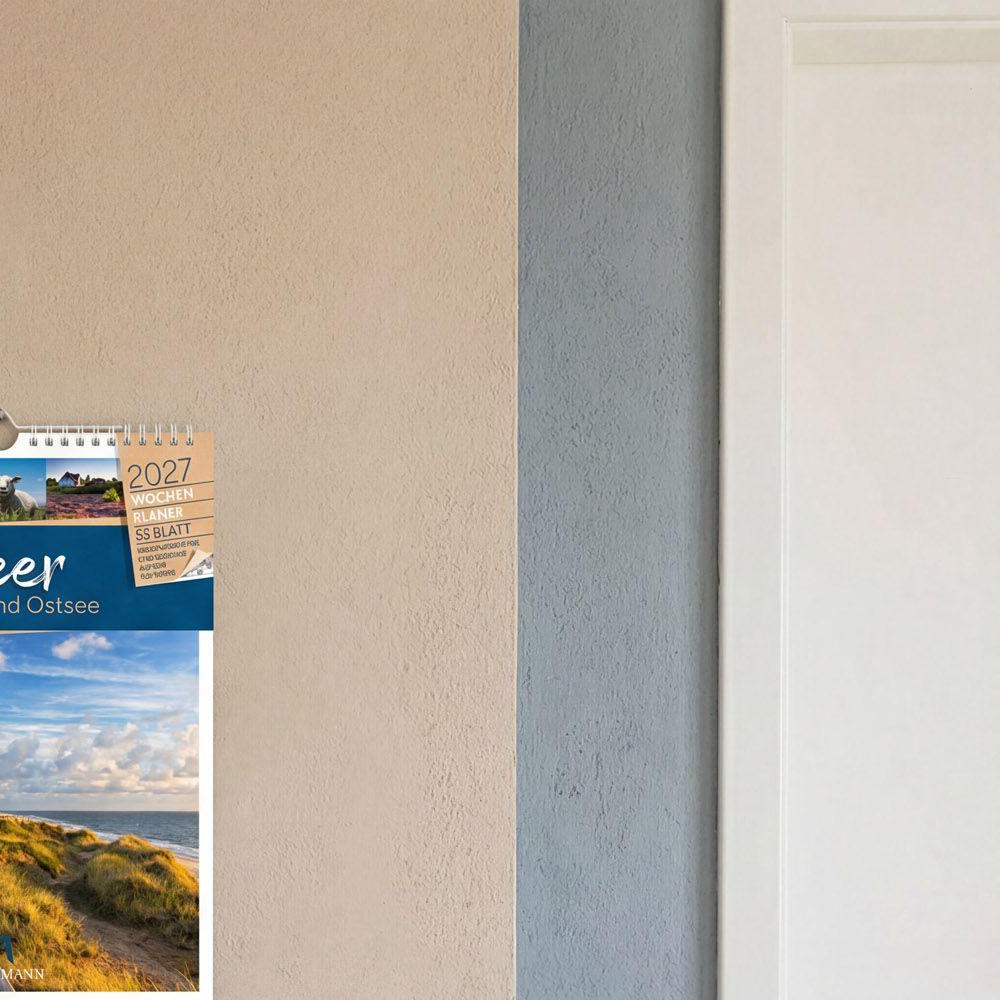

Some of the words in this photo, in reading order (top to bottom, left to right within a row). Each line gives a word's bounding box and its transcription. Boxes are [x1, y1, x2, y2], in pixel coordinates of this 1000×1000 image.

[128, 457, 192, 489] 2027
[131, 487, 194, 506] WOCHEN
[153, 523, 191, 539] BLATT
[26, 595, 100, 614] Ostsee
